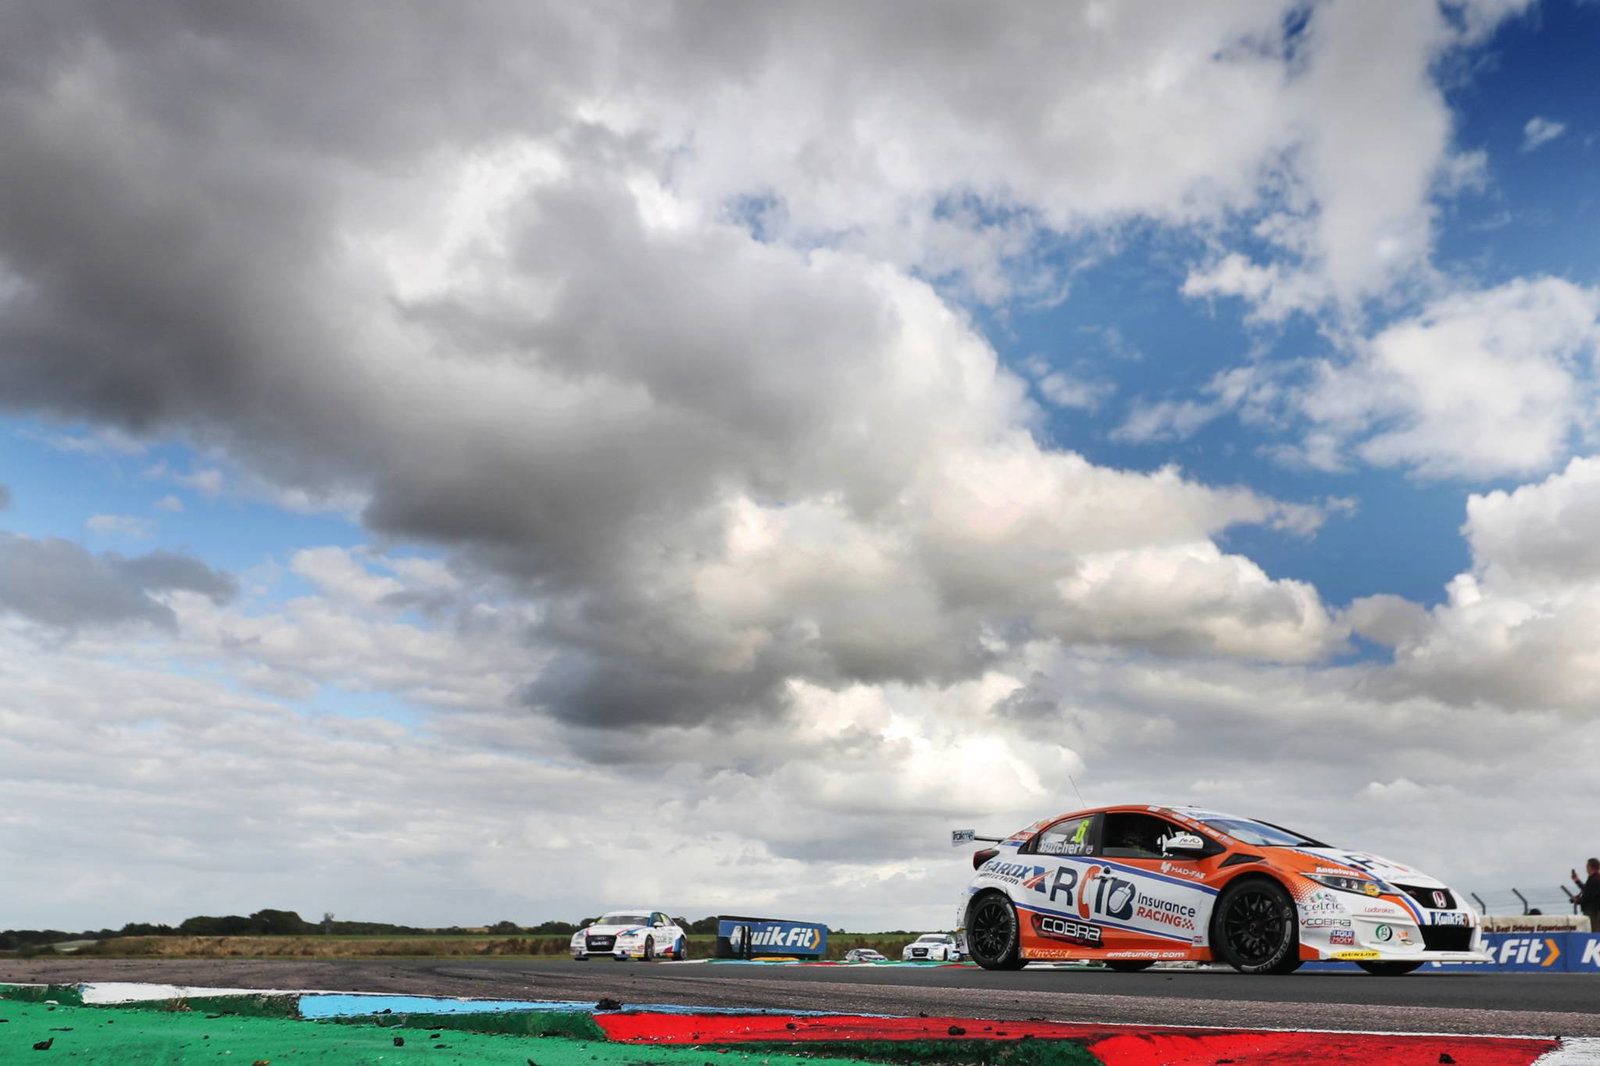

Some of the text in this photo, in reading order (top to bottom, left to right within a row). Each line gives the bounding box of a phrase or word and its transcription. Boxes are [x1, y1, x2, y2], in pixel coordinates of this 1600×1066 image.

[1074, 819, 1090, 843] 6
[1137, 892, 1196, 918] Insurance
[1136, 907, 1182, 928] RACING
[1306, 918, 1351, 927] COBRA
[1041, 917, 1101, 942] COBRA
[1106, 951, 1185, 959] amdtuning.com
